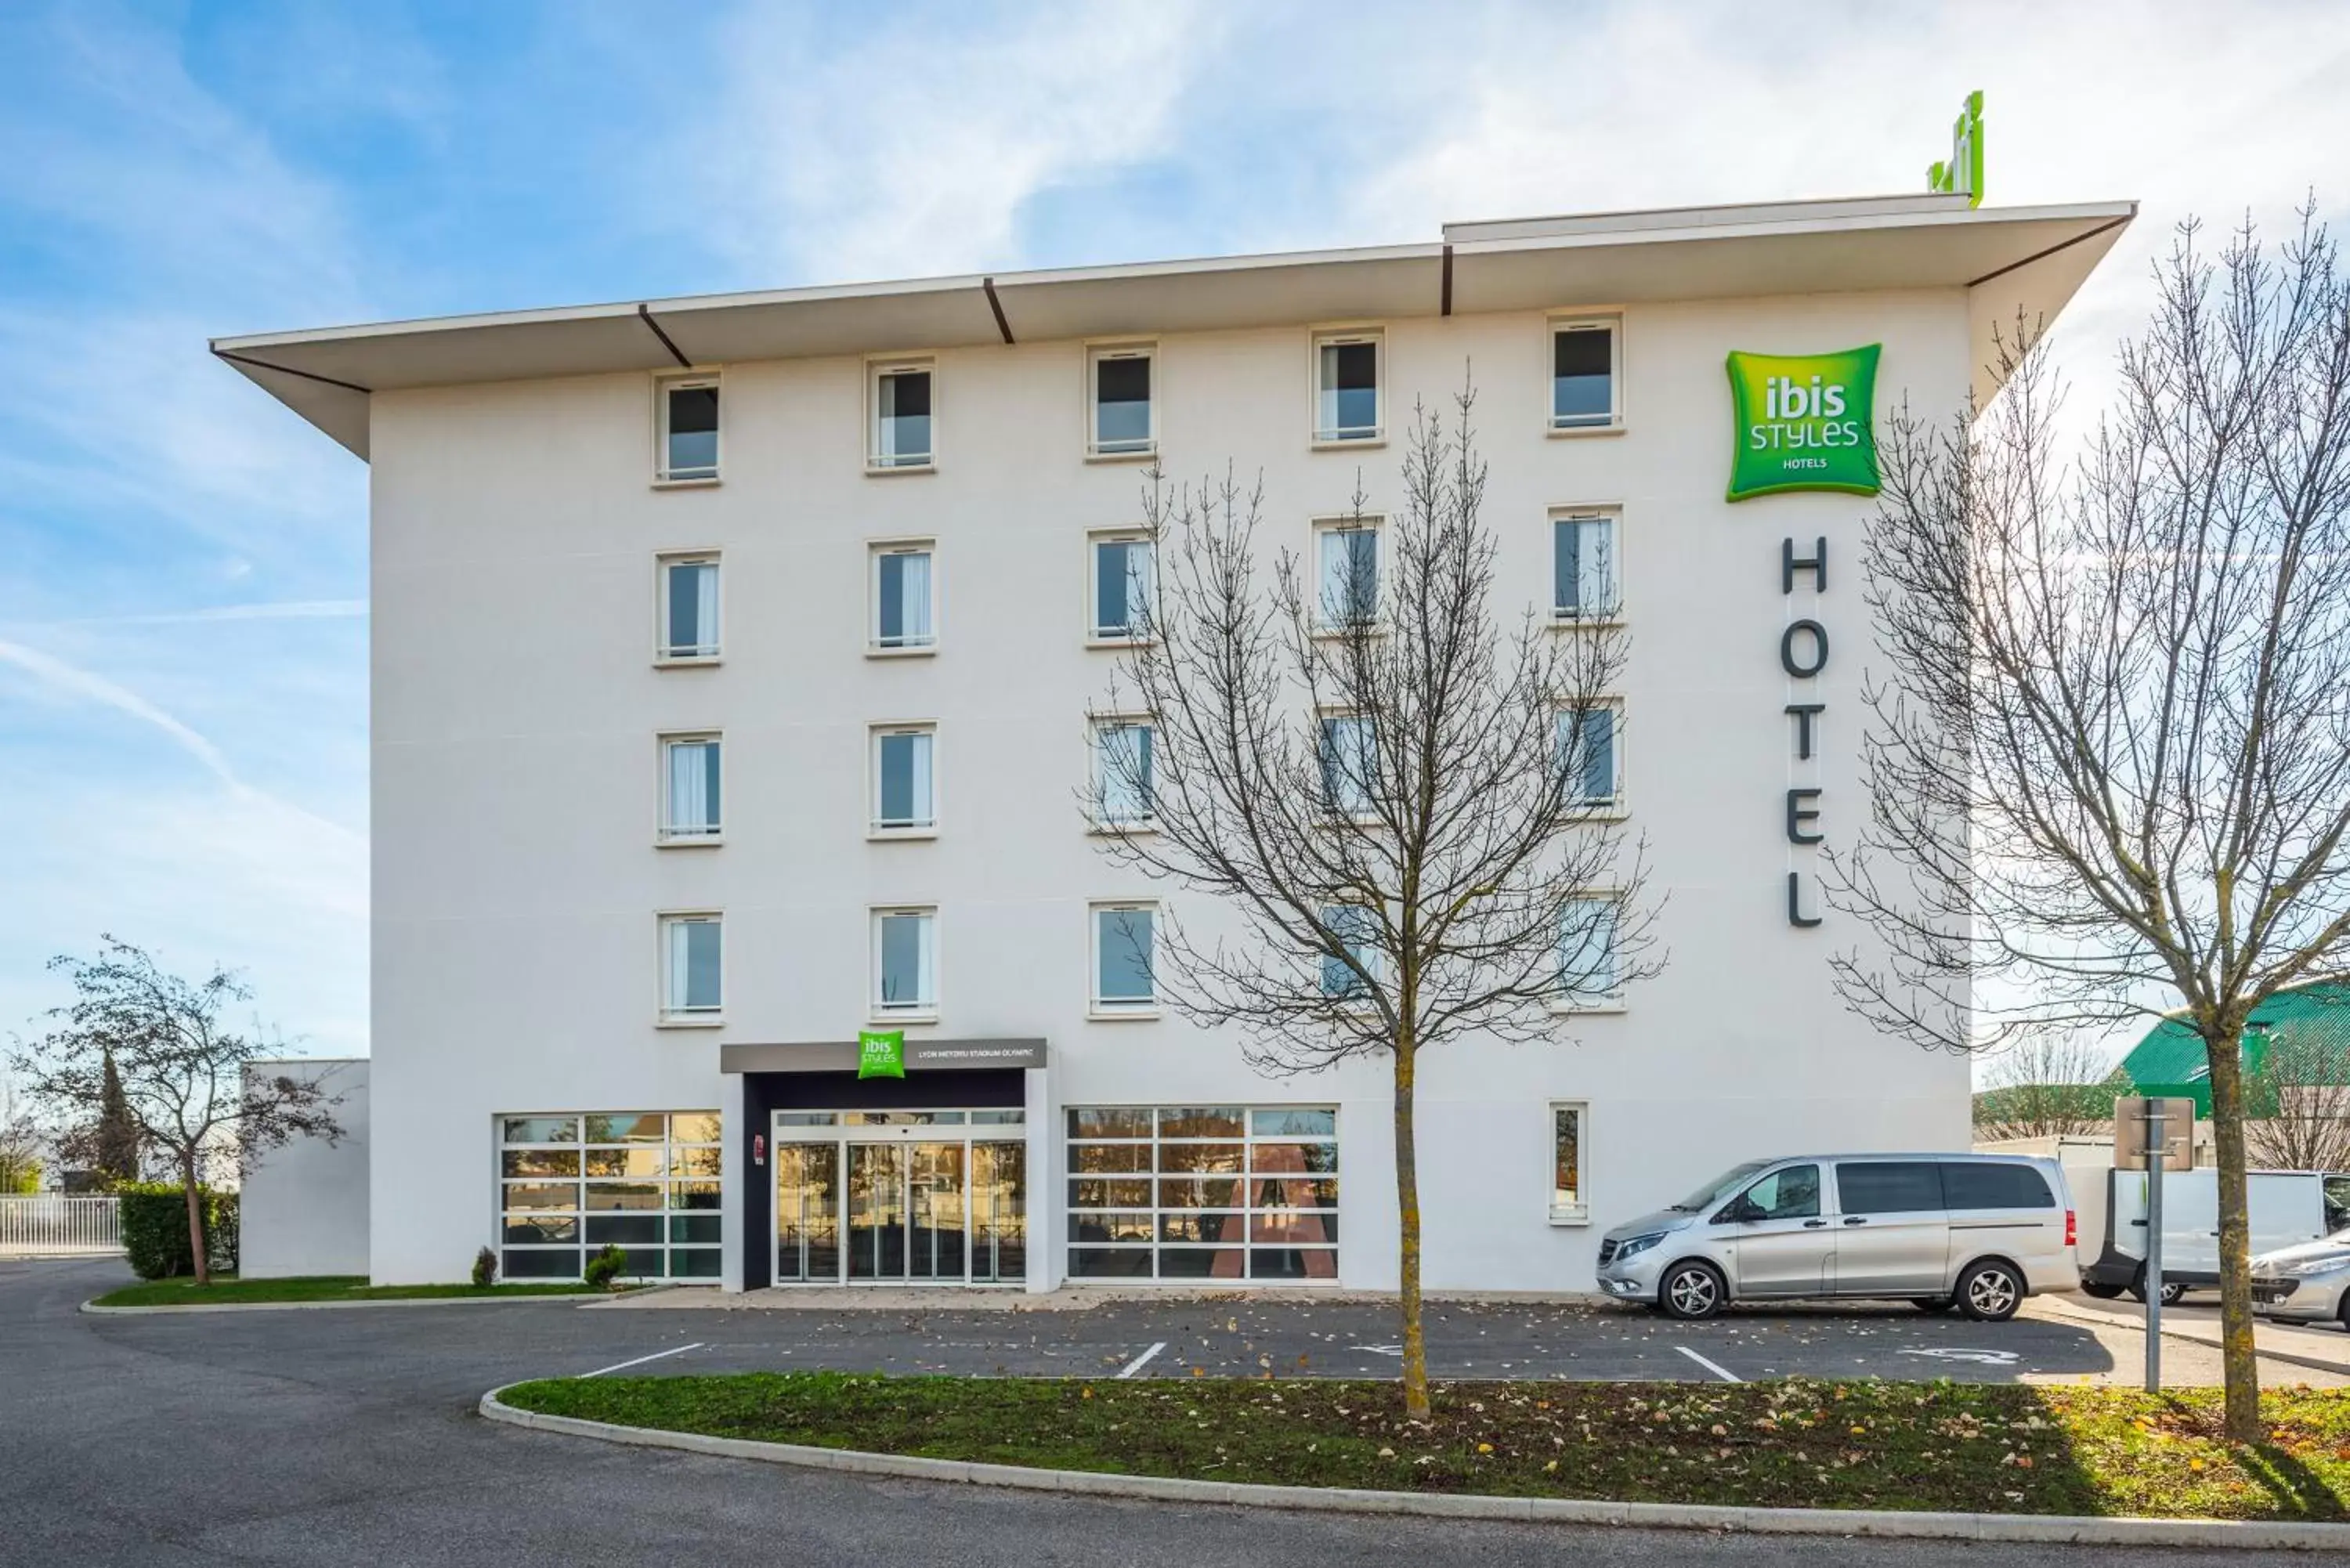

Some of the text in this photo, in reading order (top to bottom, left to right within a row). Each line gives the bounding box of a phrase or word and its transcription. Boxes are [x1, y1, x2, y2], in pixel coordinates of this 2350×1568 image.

[1767, 375, 1845, 419] ibis
[1784, 458, 1828, 469] HOTELS
[1781, 536, 1829, 928] HOTEL
[865, 1038, 891, 1053] ibis
